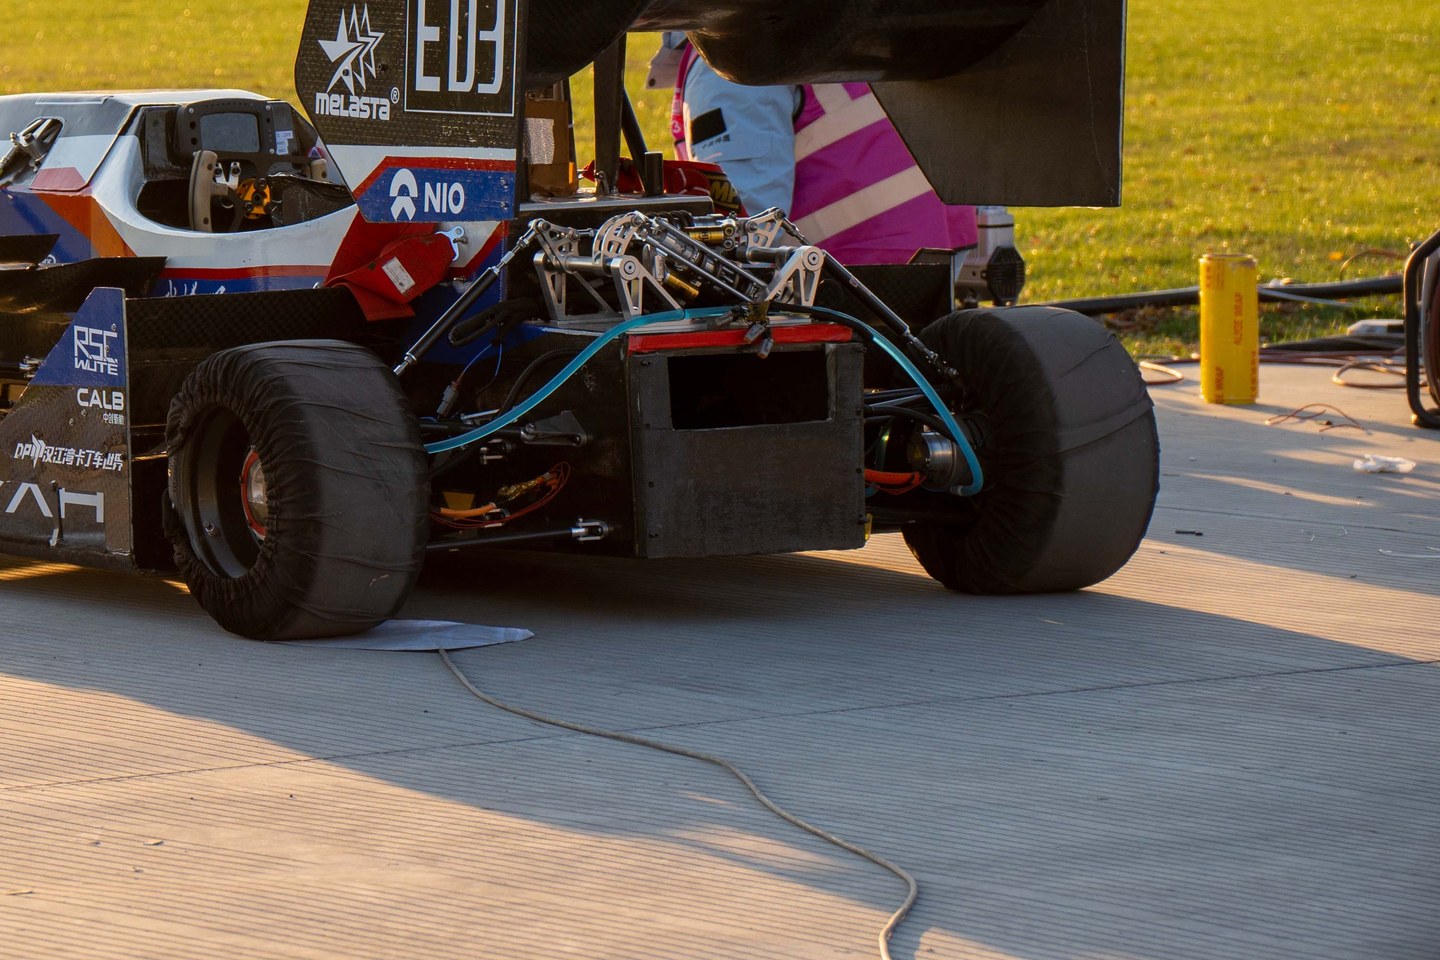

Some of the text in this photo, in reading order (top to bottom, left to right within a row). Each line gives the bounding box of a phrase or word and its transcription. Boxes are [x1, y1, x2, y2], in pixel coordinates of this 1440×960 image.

[423, 182, 465, 214] NIO
[74, 357, 118, 376] WUTE
[76, 388, 124, 411] CALB
